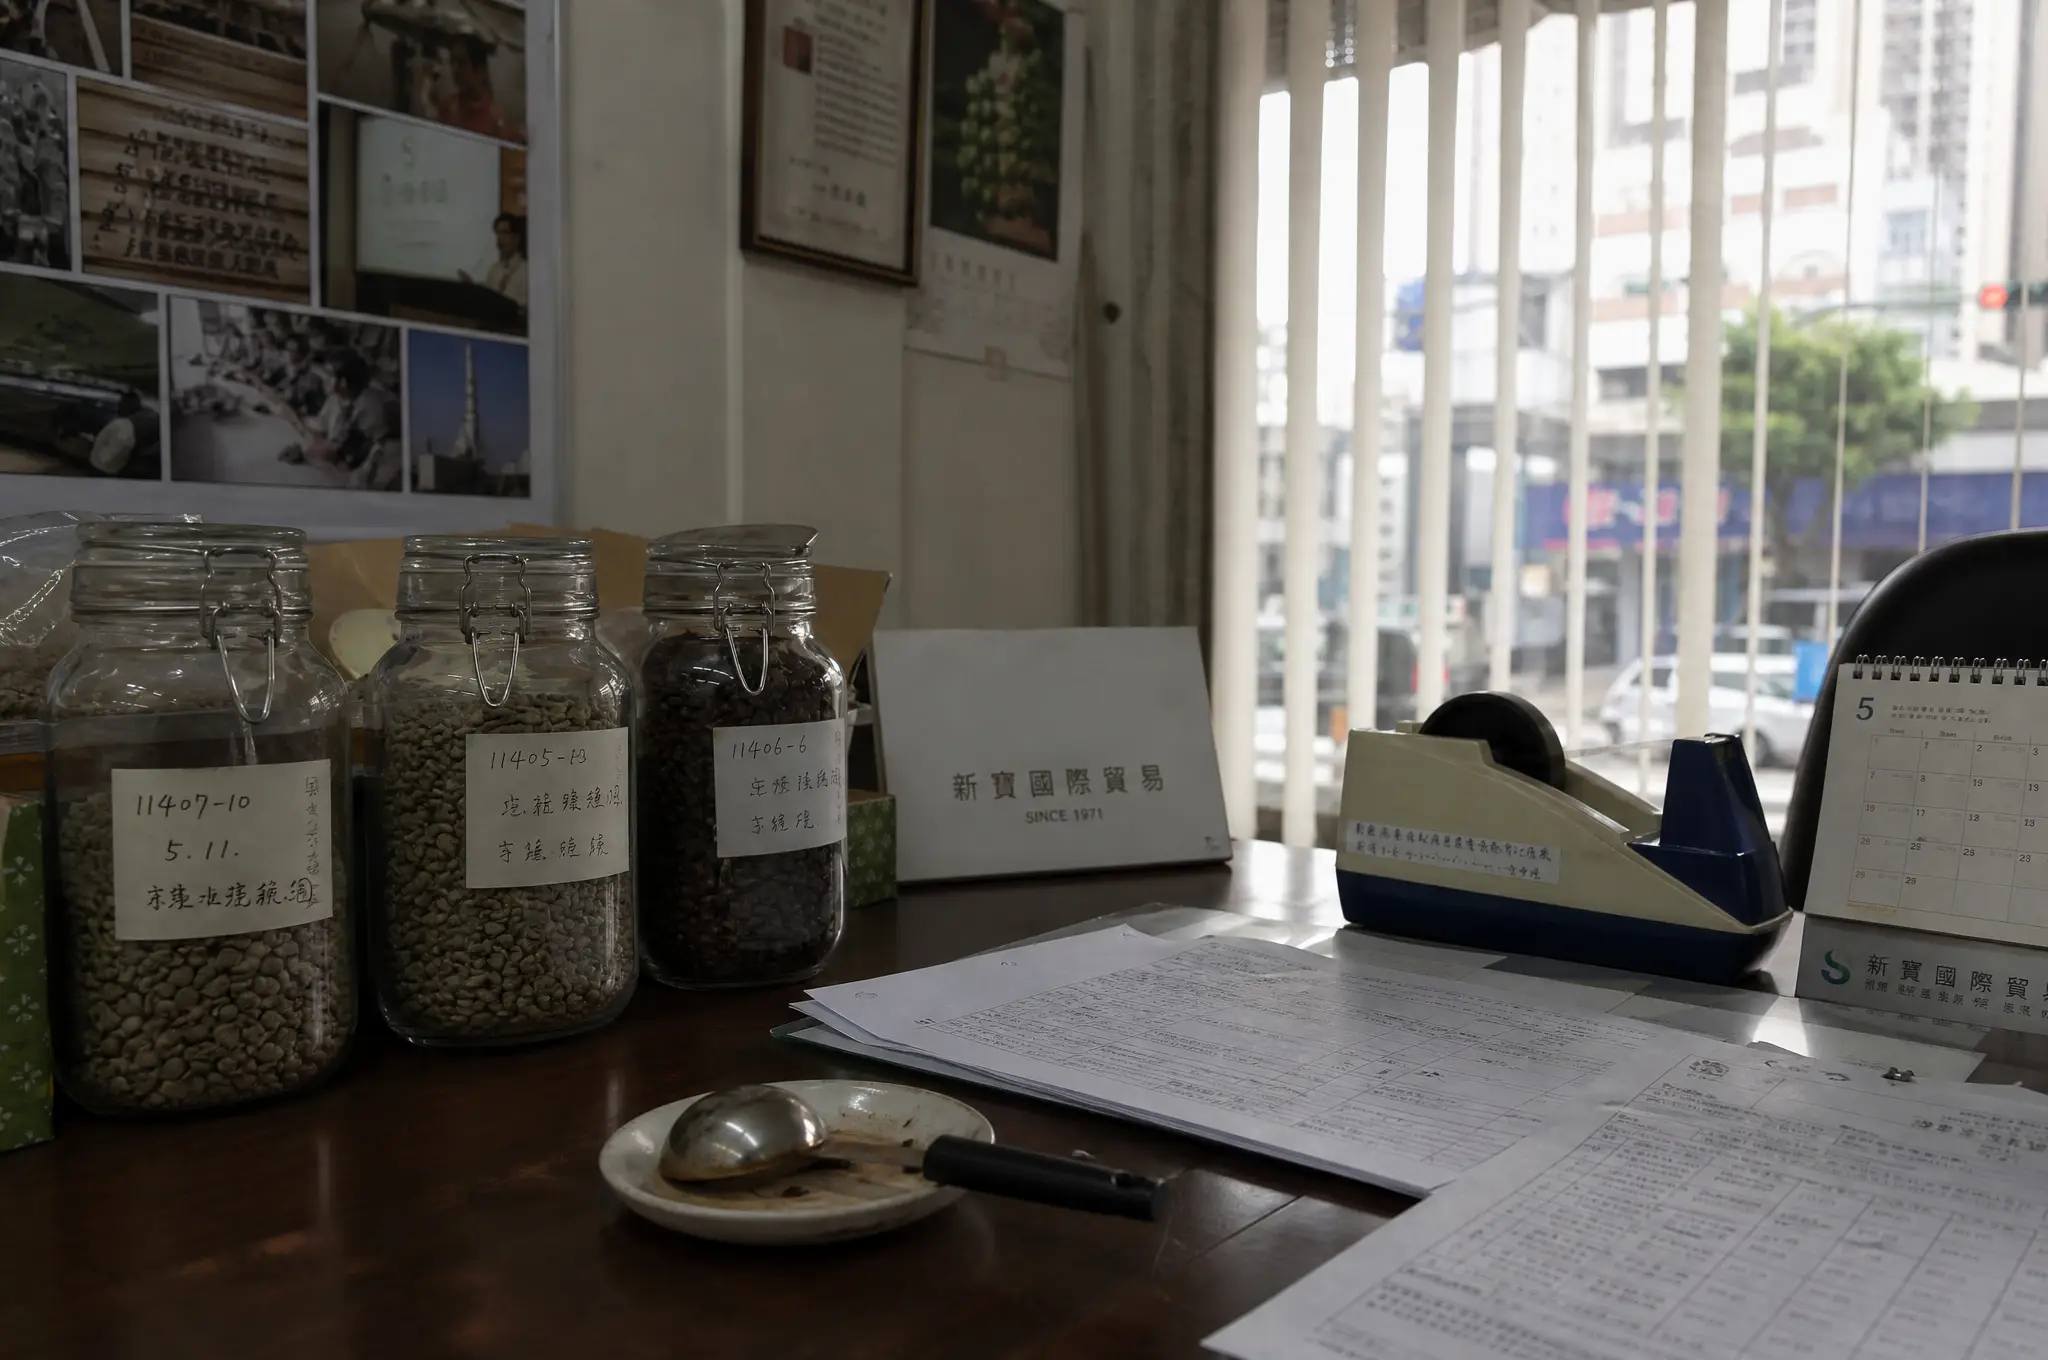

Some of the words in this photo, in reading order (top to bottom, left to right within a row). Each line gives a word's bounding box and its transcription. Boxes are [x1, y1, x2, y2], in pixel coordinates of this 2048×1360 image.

[1856, 696, 1875, 721] 5
[731, 735, 807, 760] 11406-6
[952, 764, 1164, 802] 新寶國際貿易
[137, 793, 250, 820] 11407-10
[1025, 809, 1068, 824] SINCE
[1073, 807, 1103, 822] 1971
[1866, 953, 2048, 1001] 新寶國際貿
